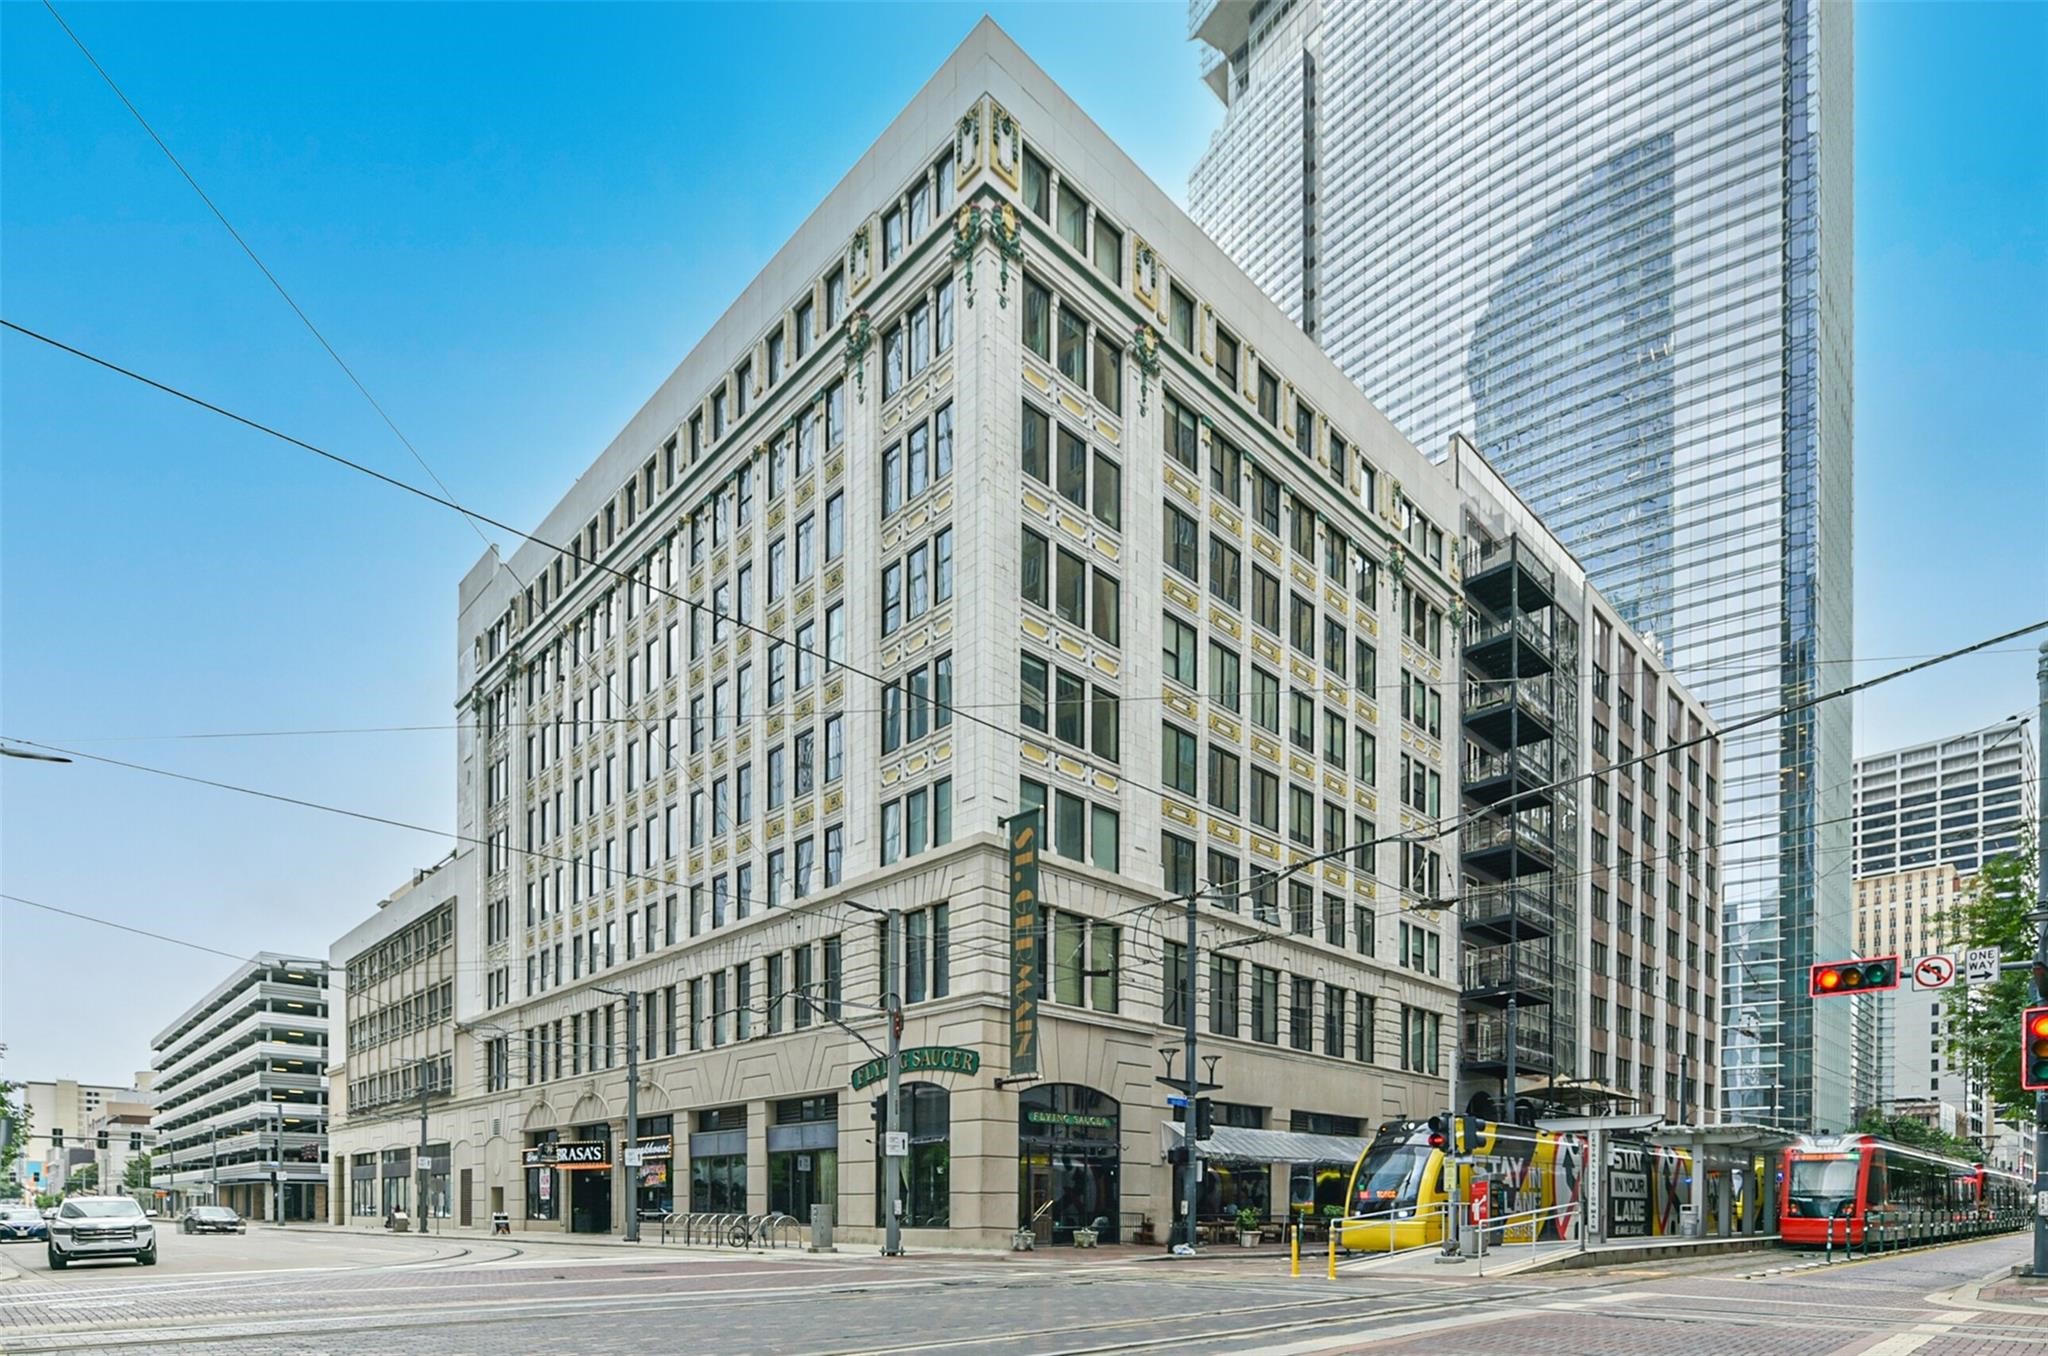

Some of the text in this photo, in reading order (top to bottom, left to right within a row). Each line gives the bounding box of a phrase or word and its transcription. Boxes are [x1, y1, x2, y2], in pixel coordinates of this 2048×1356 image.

[1968, 960, 1995, 970] WAY
[1969, 950, 1995, 961] ONE
[1014, 888, 1035, 1058] GERMAIN
[857, 1049, 973, 1085] FLYIG SAUCER
[1033, 1111, 1069, 1123] FLYING
[1613, 1151, 1642, 1171] STAY
[1489, 1156, 1524, 1188] TAY
[1614, 1177, 1646, 1194] IN YOUR
[1590, 1208, 1598, 1230] MAIN
[1614, 1200, 1645, 1222] LANE
